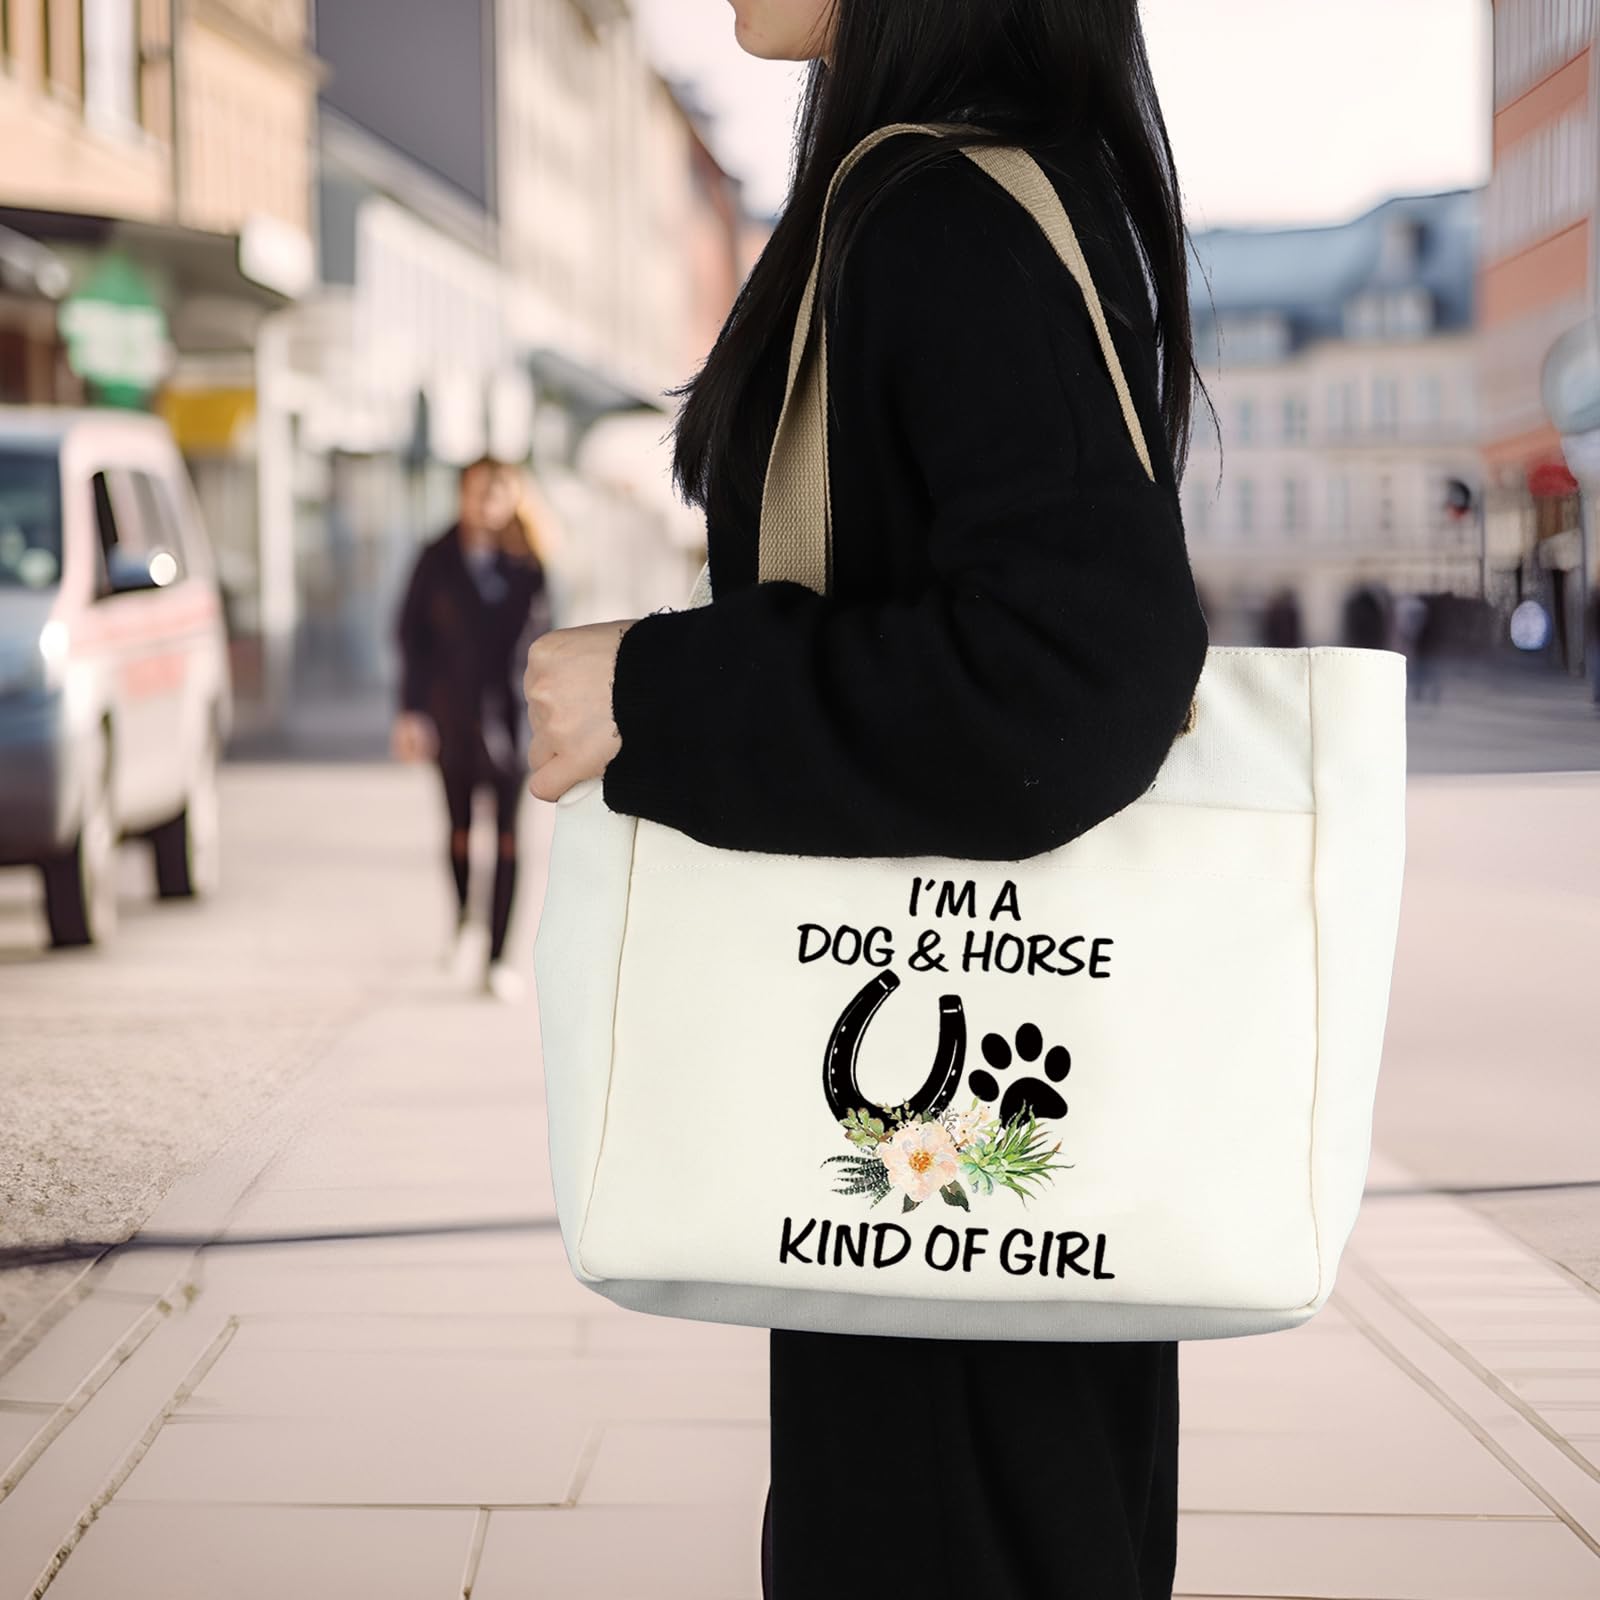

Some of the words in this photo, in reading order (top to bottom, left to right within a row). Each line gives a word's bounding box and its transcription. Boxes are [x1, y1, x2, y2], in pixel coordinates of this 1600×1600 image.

[908, 876, 977, 919] I'M
[989, 879, 1022, 922] A
[797, 923, 895, 968] DOG
[908, 929, 949, 973] &
[962, 930, 1114, 979] HORSE
[779, 1216, 912, 1269] KIND
[924, 1224, 989, 1273] OF
[999, 1228, 1116, 1280] GIRL
